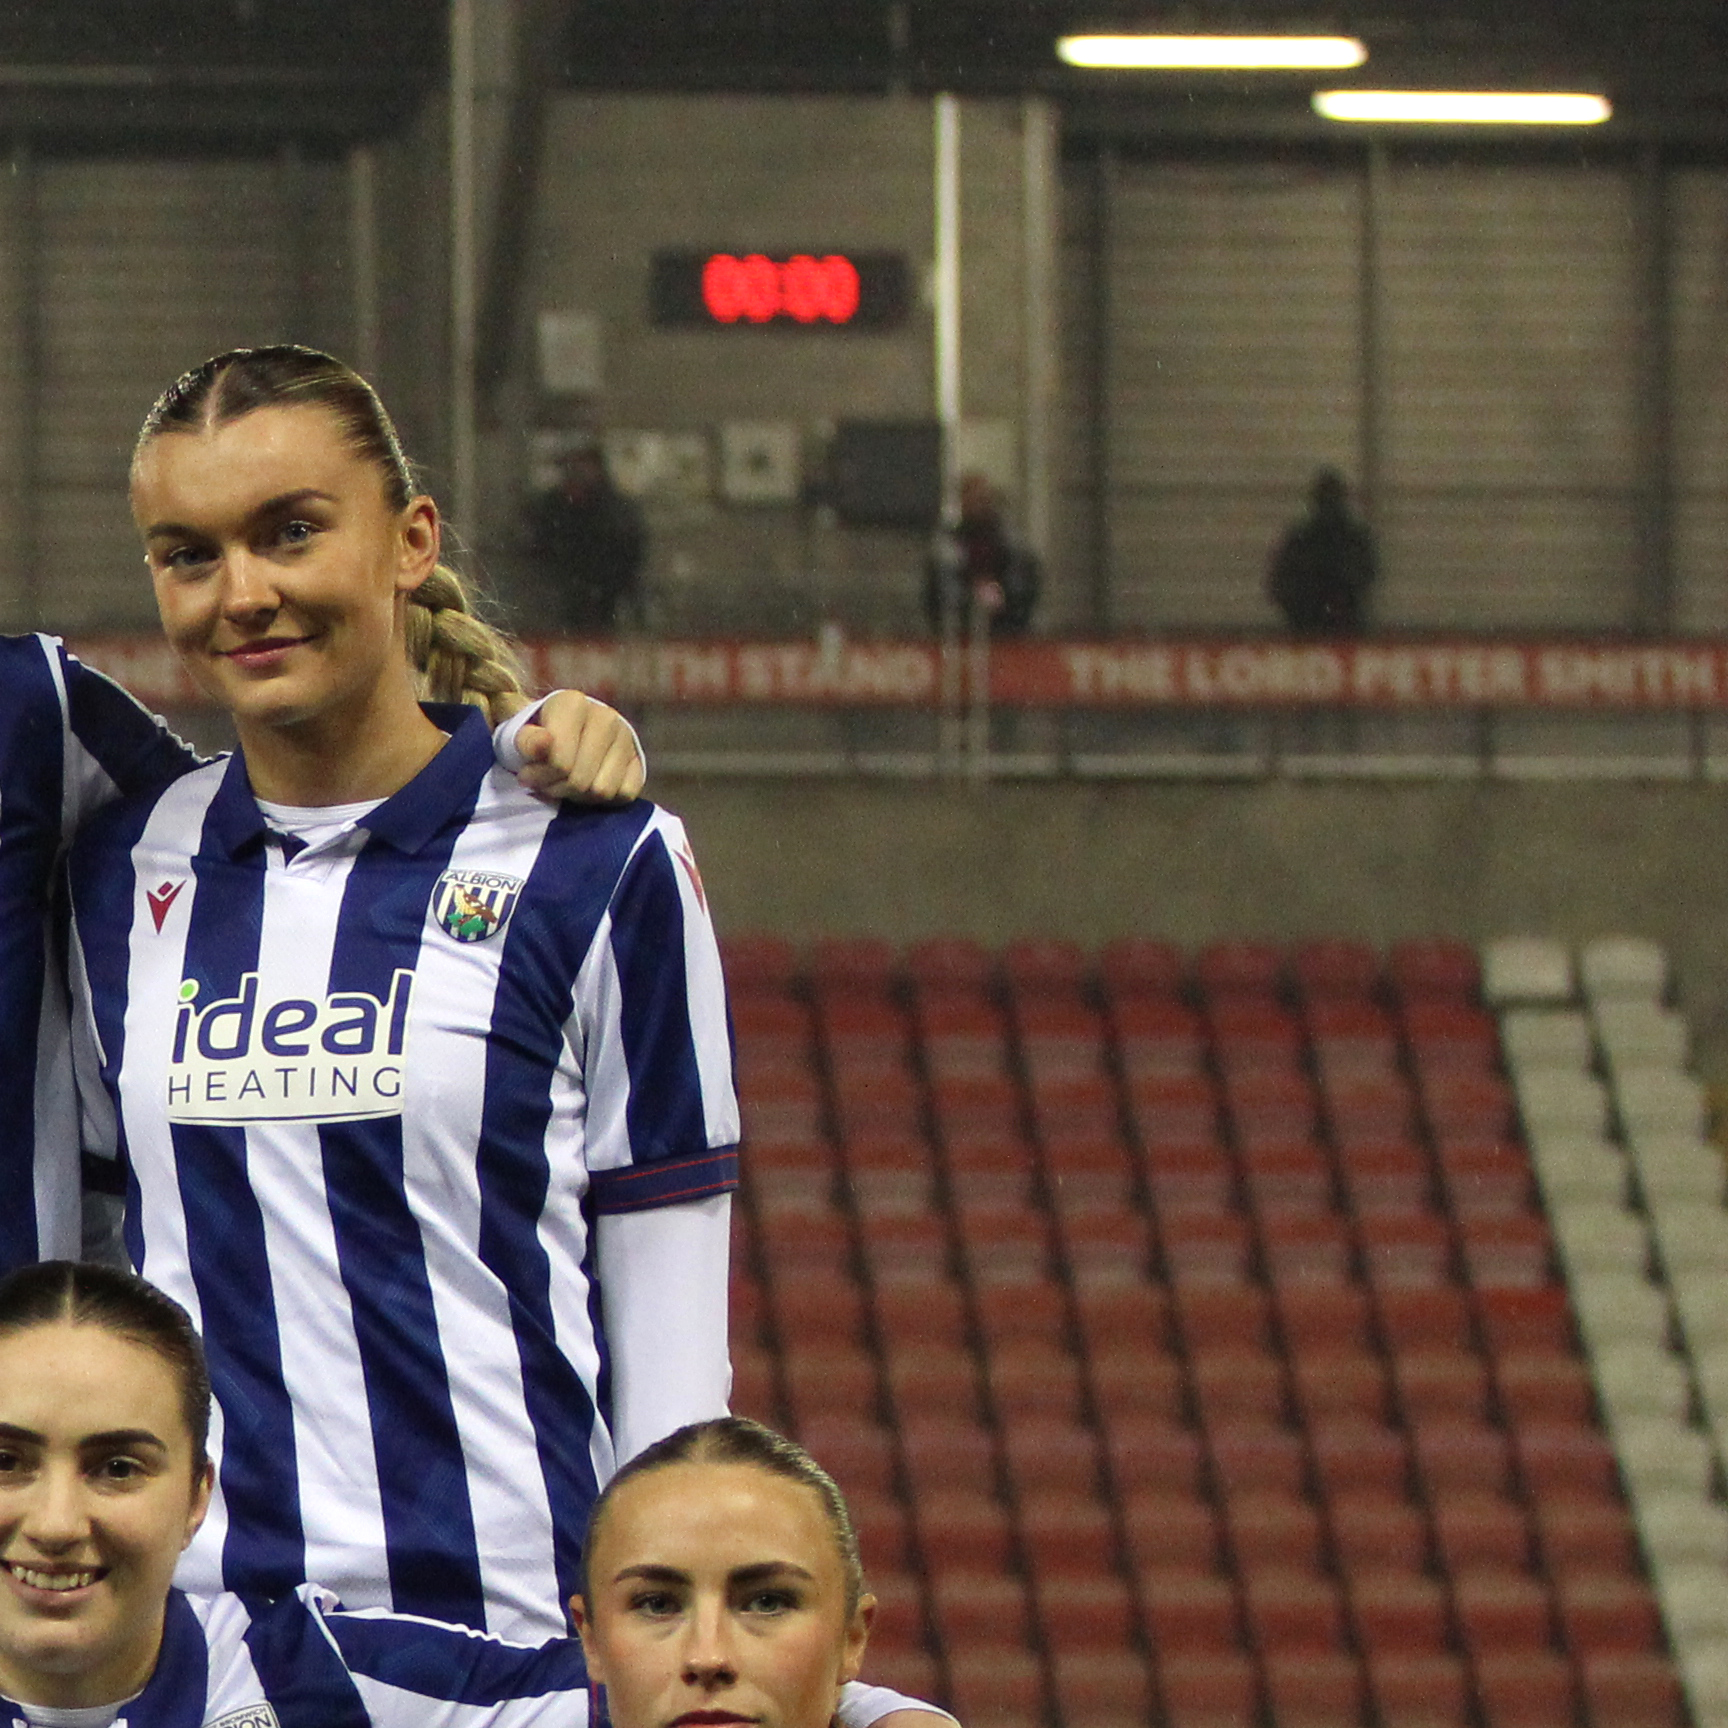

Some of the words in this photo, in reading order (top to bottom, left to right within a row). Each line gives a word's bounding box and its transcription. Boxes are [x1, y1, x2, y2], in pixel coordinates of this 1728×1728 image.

[1068, 647, 1172, 697] THE
[1185, 647, 1342, 697] LORD
[1355, 647, 1522, 697] PETER
[1542, 647, 1715, 697] SMITH
[446, 872, 516, 891] ALBION
[171, 969, 412, 1064] ideal
[167, 1066, 403, 1106] HEATING
